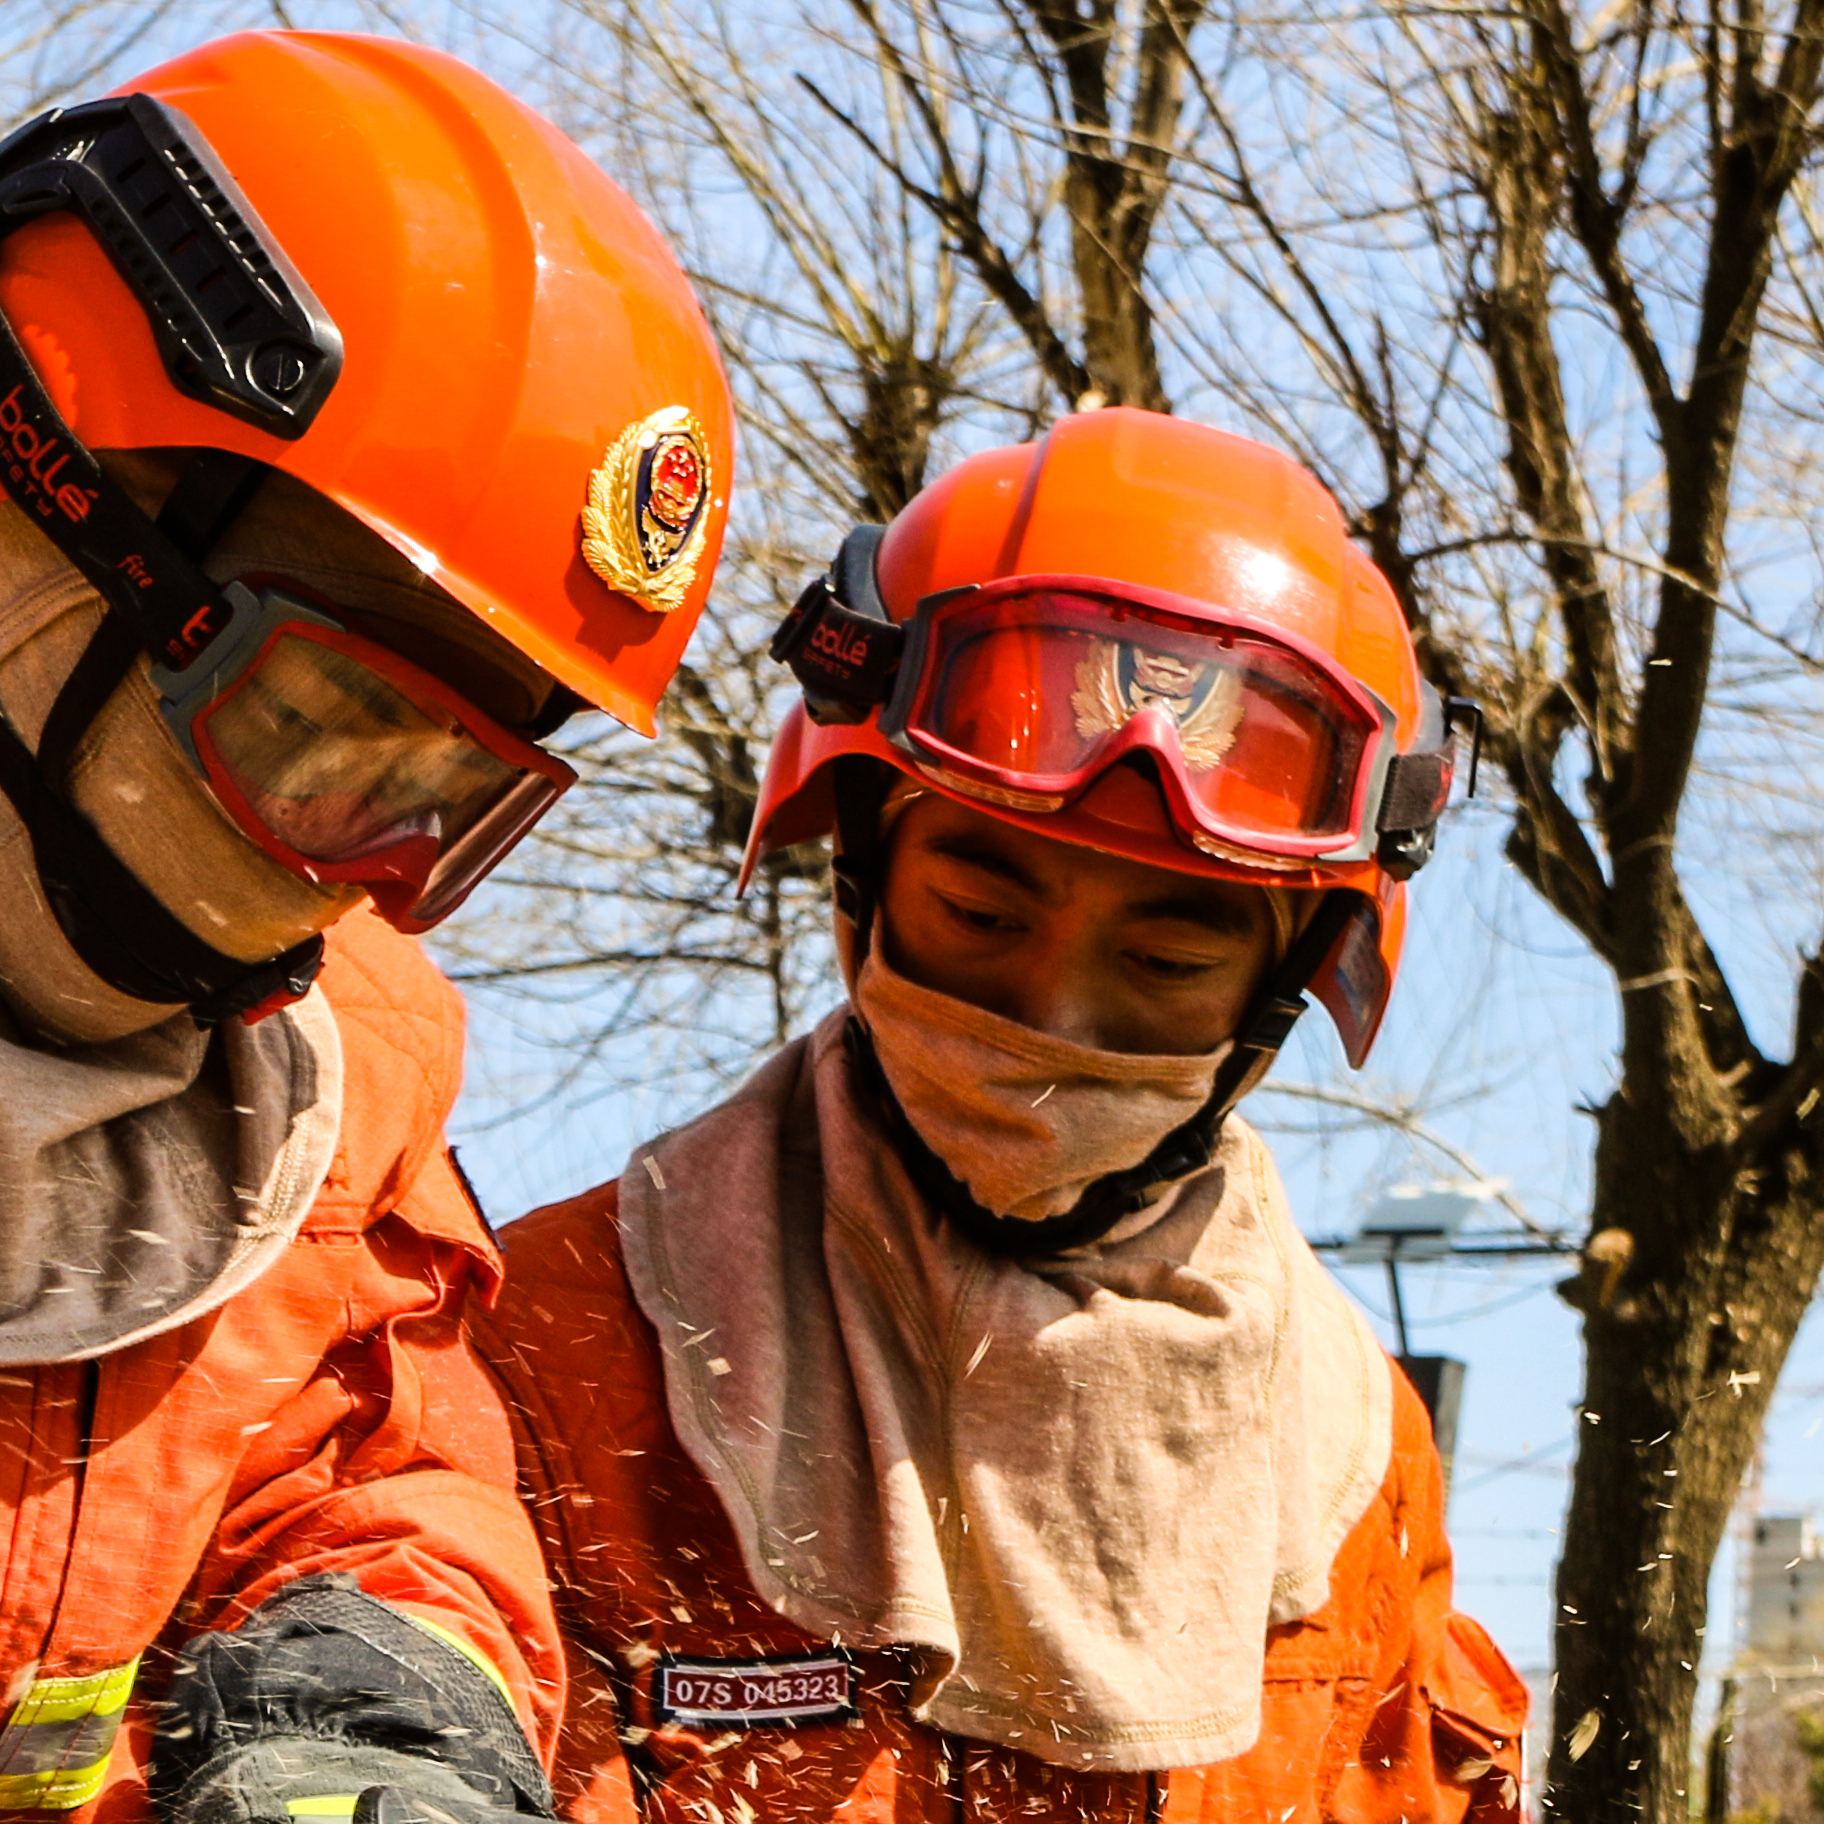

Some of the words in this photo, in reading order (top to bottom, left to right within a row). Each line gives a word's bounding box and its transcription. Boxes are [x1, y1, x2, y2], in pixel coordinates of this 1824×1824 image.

[114, 554, 155, 590] fire
[676, 1679, 732, 1705] 07S
[743, 1675, 839, 1705] 045323
